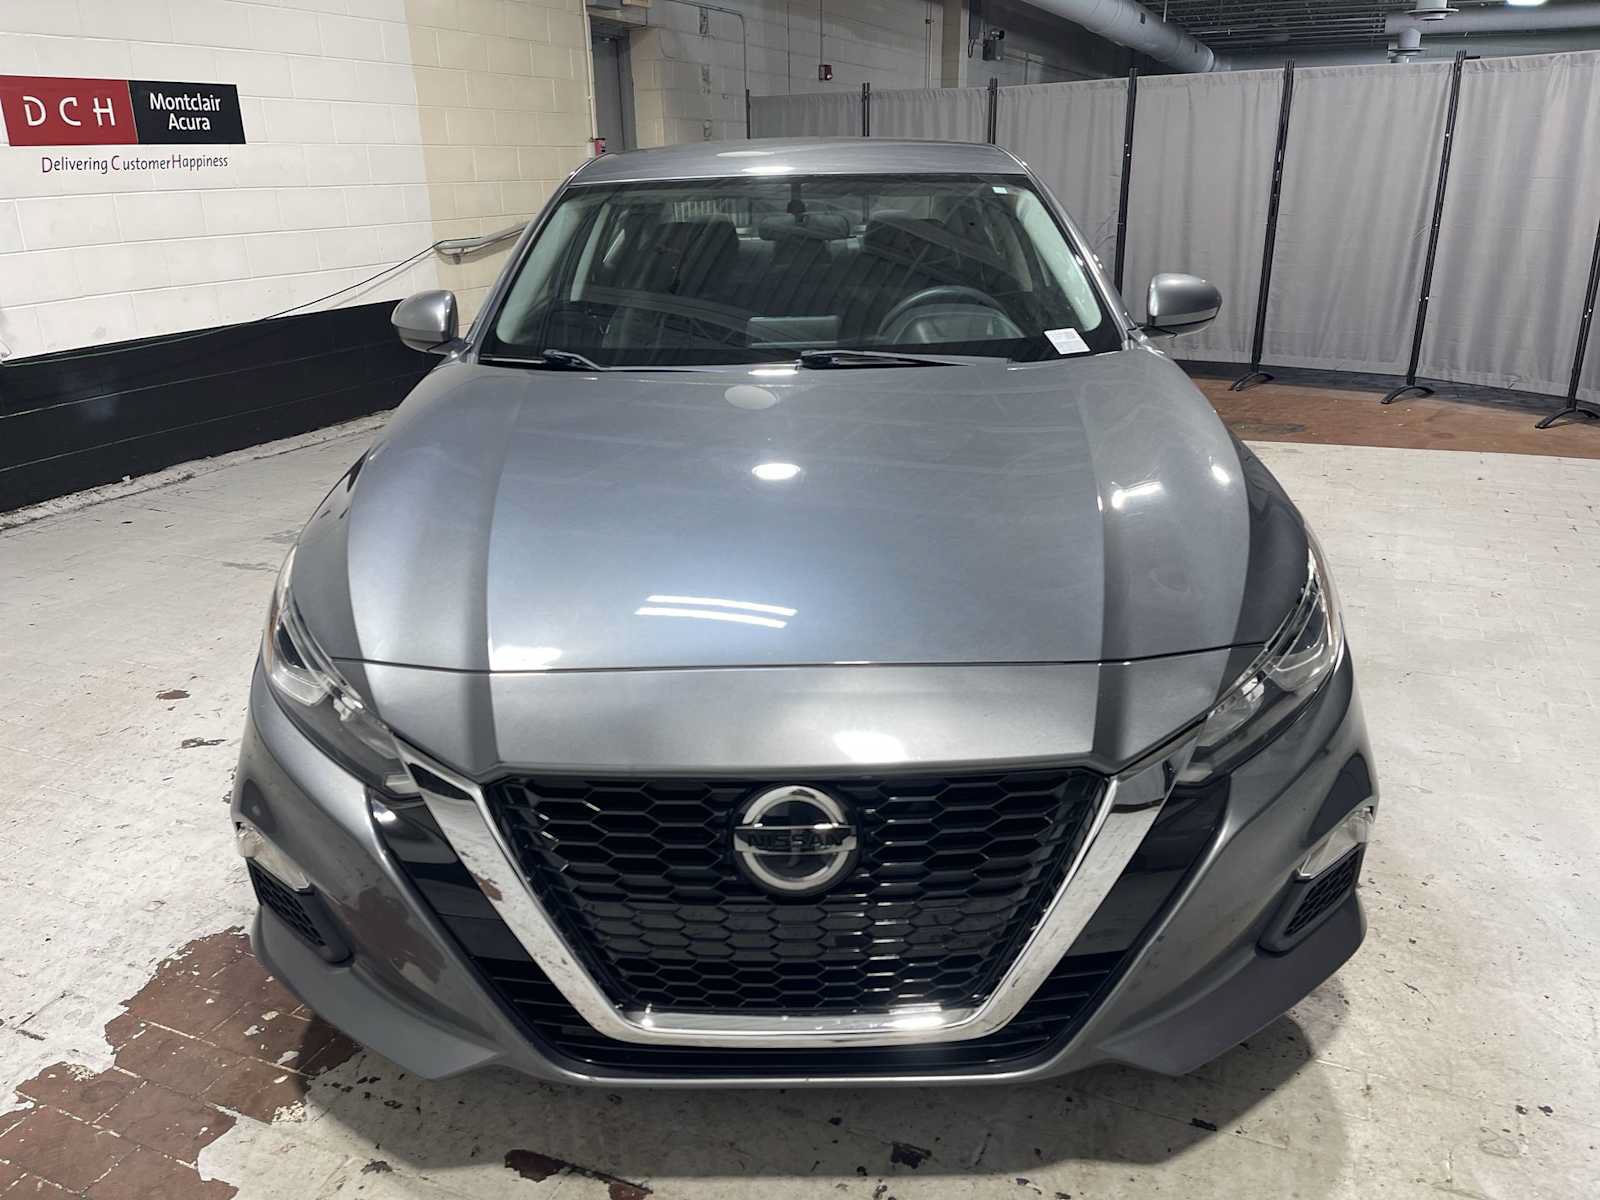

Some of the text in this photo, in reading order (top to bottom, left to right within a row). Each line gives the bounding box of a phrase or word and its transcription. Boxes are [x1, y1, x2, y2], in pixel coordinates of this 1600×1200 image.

[22, 96, 116, 127] DCH
[150, 93, 221, 112] Montclair
[168, 114, 211, 131] Acura
[41, 154, 229, 174] Delivering Customer Happiness
